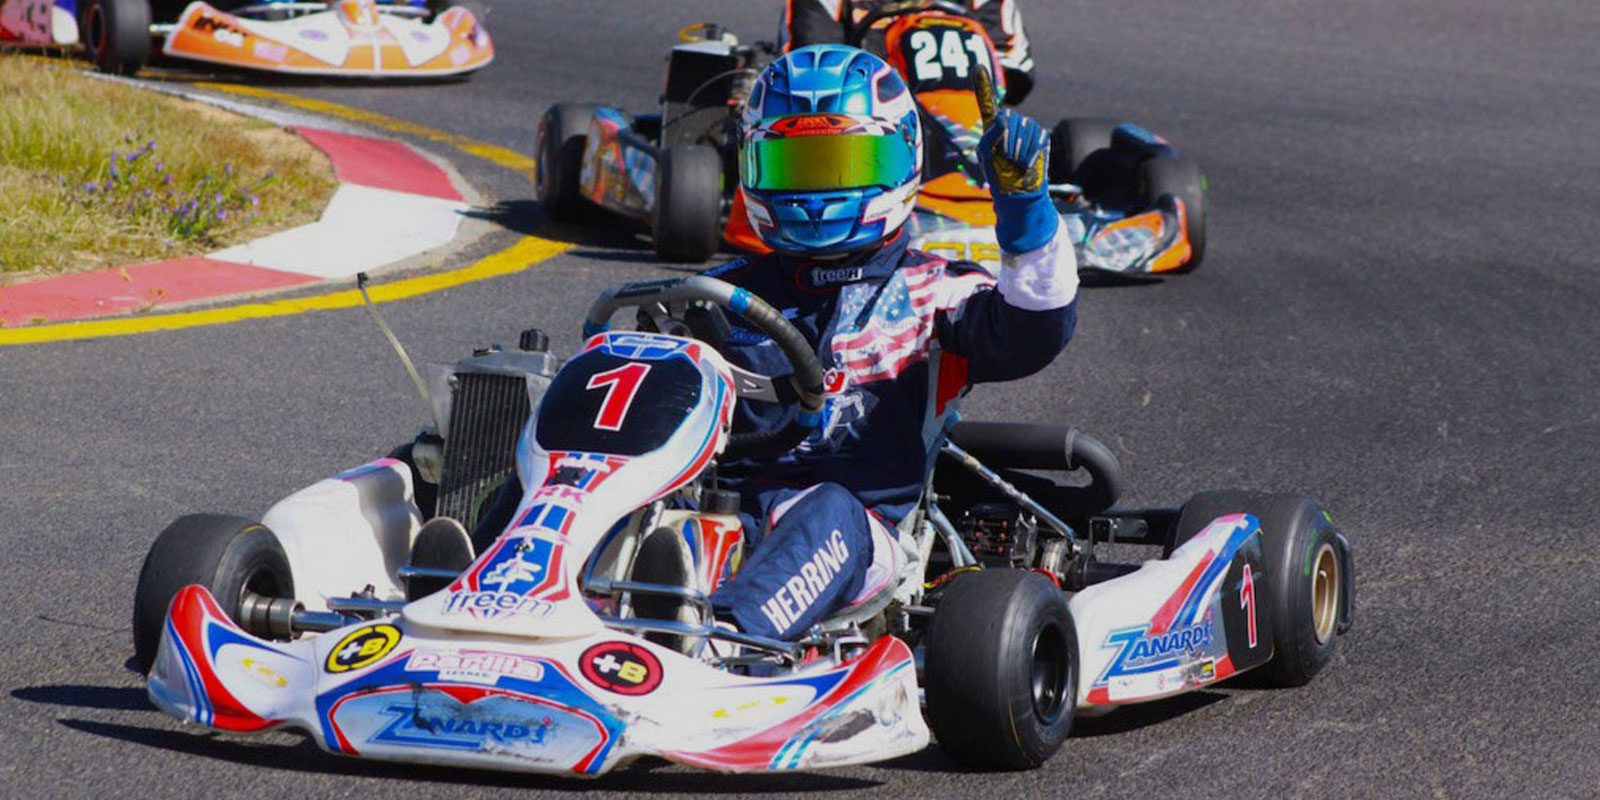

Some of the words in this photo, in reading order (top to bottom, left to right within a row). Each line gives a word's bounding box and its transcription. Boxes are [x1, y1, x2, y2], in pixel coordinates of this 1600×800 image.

[910, 30, 993, 80] 241
[586, 362, 652, 431] 1
[446, 591, 555, 617] freem
[761, 529, 849, 635] HERRING
[1240, 563, 1258, 648] 1
